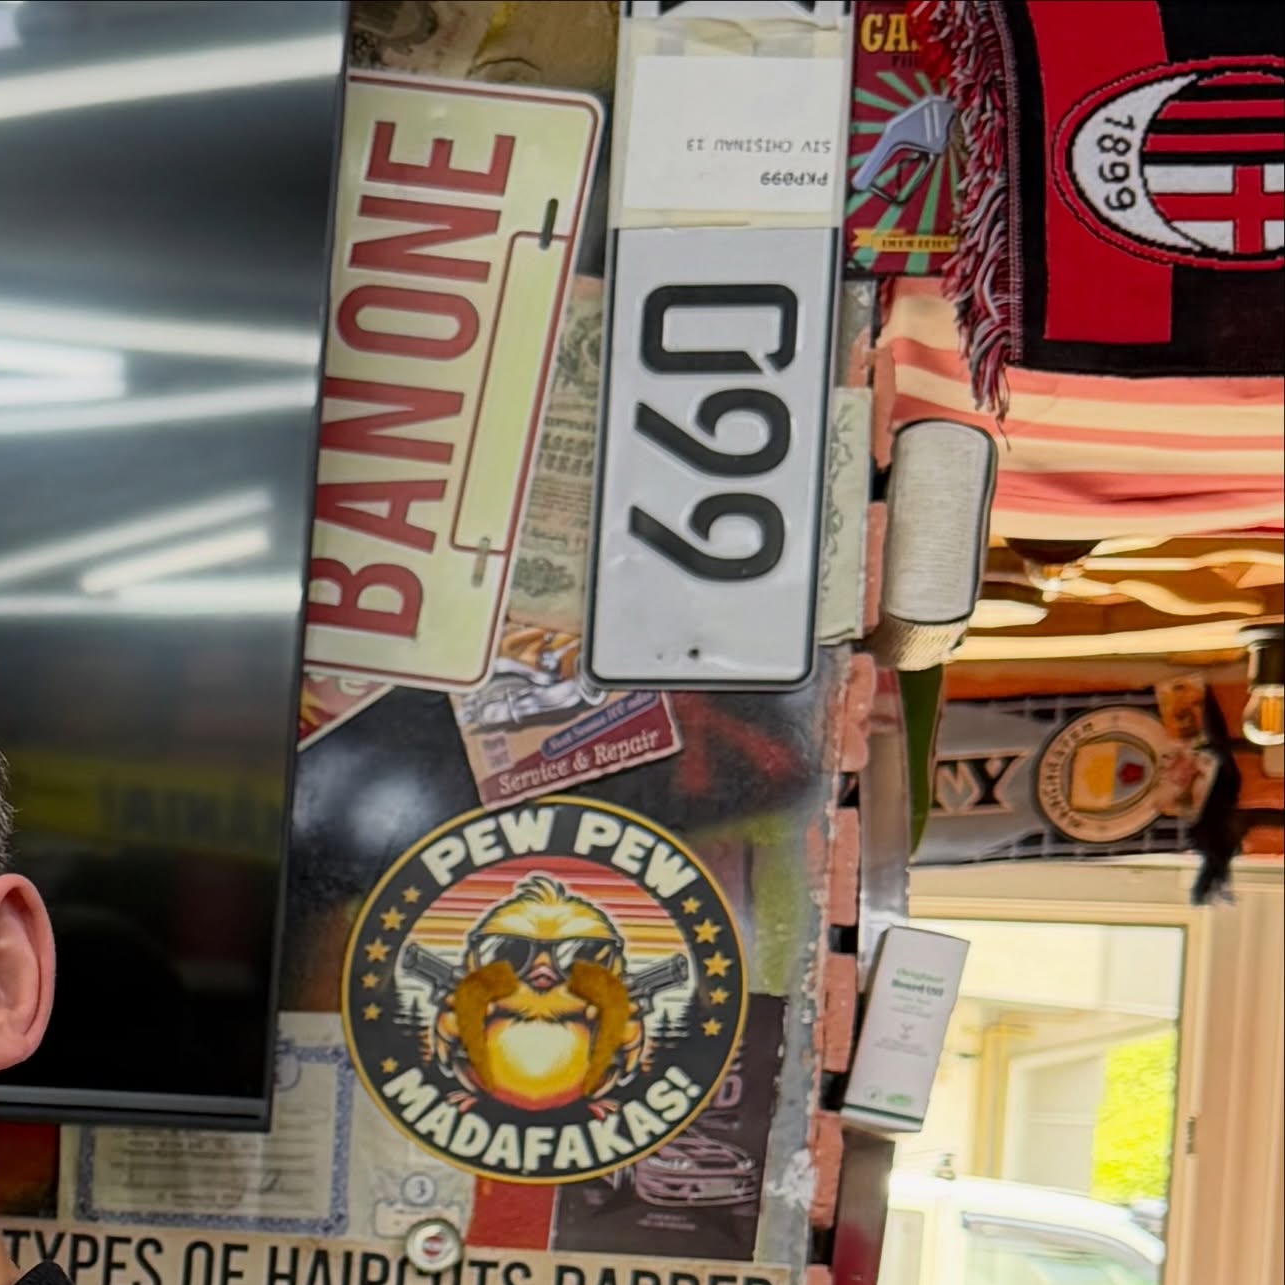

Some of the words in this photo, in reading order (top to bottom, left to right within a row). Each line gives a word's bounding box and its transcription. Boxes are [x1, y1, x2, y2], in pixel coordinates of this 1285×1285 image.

[861, 13, 919, 52] GA
[1097, 115, 1135, 211] 1899
[498, 759, 569, 796] Service
[594, 728, 662, 766] Repair
[421, 806, 555, 887] PEW
[573, 812, 698, 898] PEW
[381, 1065, 704, 1172] MADAFAKAS!
